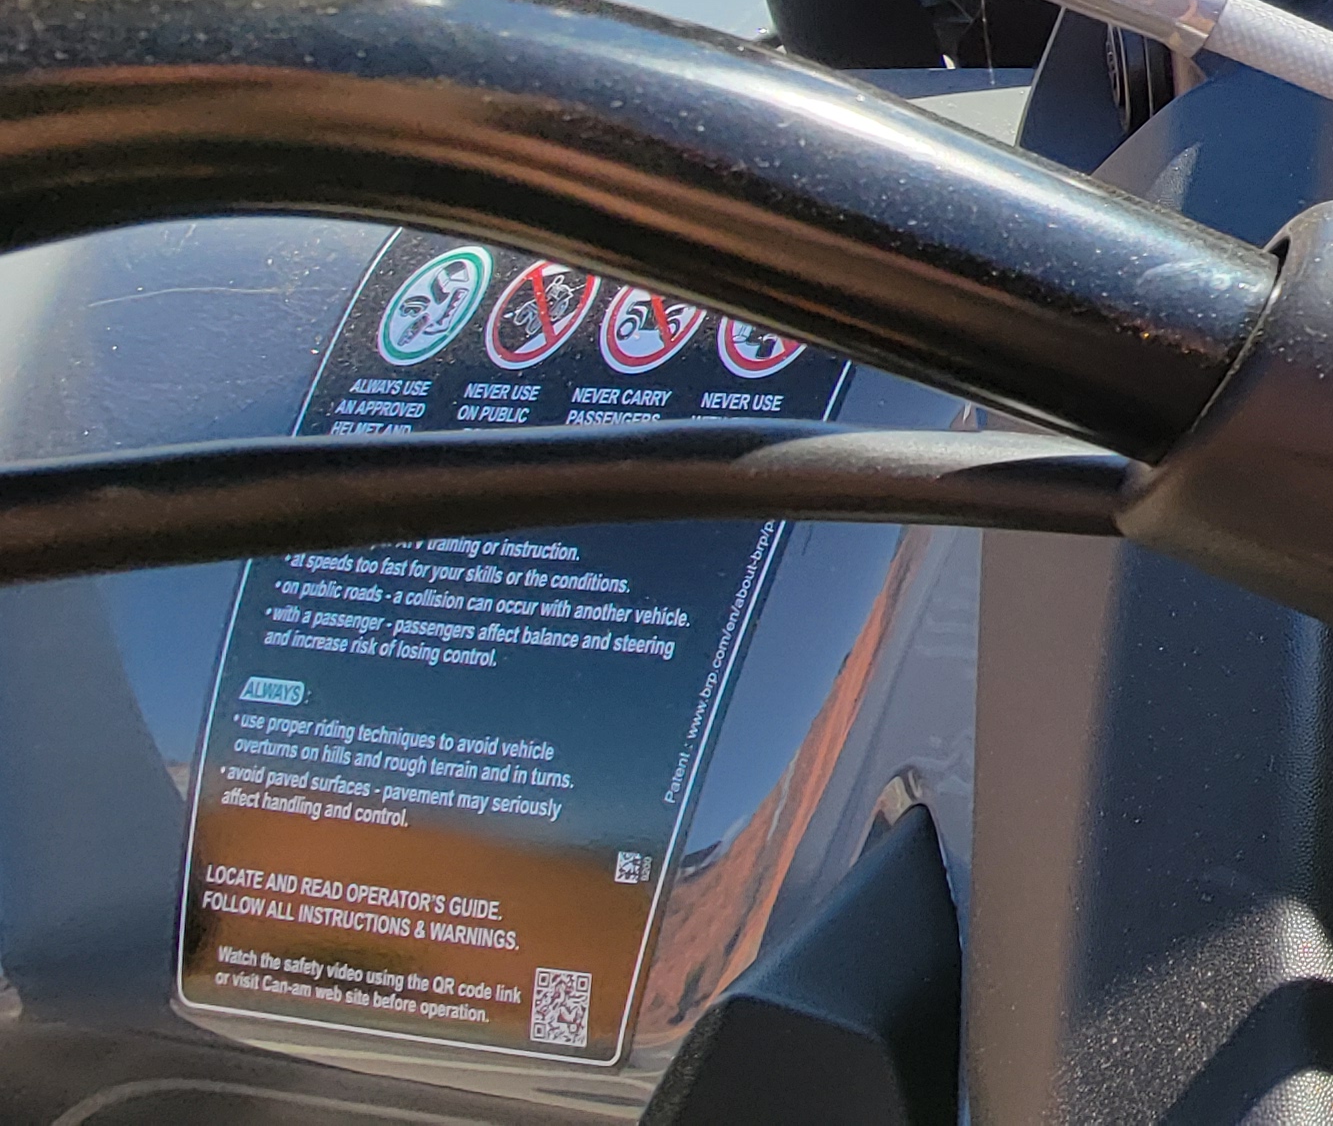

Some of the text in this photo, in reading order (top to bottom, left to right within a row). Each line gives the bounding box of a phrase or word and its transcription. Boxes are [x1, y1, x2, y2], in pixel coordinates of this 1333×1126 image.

[349, 378, 433, 396] ALWAYS USE
[463, 383, 541, 401] NEVER USE
[571, 387, 673, 406] NEVER CARRY
[700, 392, 784, 412] NEVER USE
[335, 399, 427, 419] AN APPROVED
[457, 405, 530, 423] ON PUBLIC
[482, 541, 501, 555] or
[500, 538, 580, 561] instruction.
[290, 554, 631, 593] at speeds too fast for your skills or the conditions.
[281, 581, 299, 594] on
[300, 579, 342, 600] public
[343, 584, 383, 602] roads
[393, 591, 402, 604] a
[405, 588, 464, 610] collision
[466, 597, 492, 613] can
[495, 599, 538, 615] occur
[540, 599, 571, 619] with
[574, 603, 633, 623] another
[635, 606, 691, 627] vehicle.
[264, 629, 497, 667] and increase risk of losing control.
[272, 605, 300, 623] with
[301, 610, 311, 623] a
[311, 612, 385, 634] passenger
[393, 618, 476, 642] passengers
[478, 623, 520, 643] affect
[522, 627, 579, 648] balance
[582, 632, 612, 651] and
[613, 636, 676, 660] steering
[664, 752, 690, 804] Patent
[687, 520, 775, 739] www.brp.com/en/about-brp/p
[240, 714, 555, 761] use proper riding techniques to avoid vehicle
[234, 737, 574, 788] overturns on hills and rough terrain and in turns.
[221, 787, 408, 827] affect handling and control.
[227, 766, 265, 783] avoid
[265, 768, 310, 788] paved
[309, 774, 370, 796] surfaces
[382, 783, 456, 807] pavement
[457, 793, 490, 814] may
[491, 795, 562, 821] seriously
[206, 864, 264, 889] LOCATE
[265, 873, 298, 893] AND
[300, 877, 343, 901] READ
[202, 890, 520, 951] FOLLOW ALL INSTRUCTIONS & WARNINGS.
[218, 945, 521, 1004] Watch the safety video using the QR code link
[215, 970, 490, 1023] or visit Can-am web site before operation.
